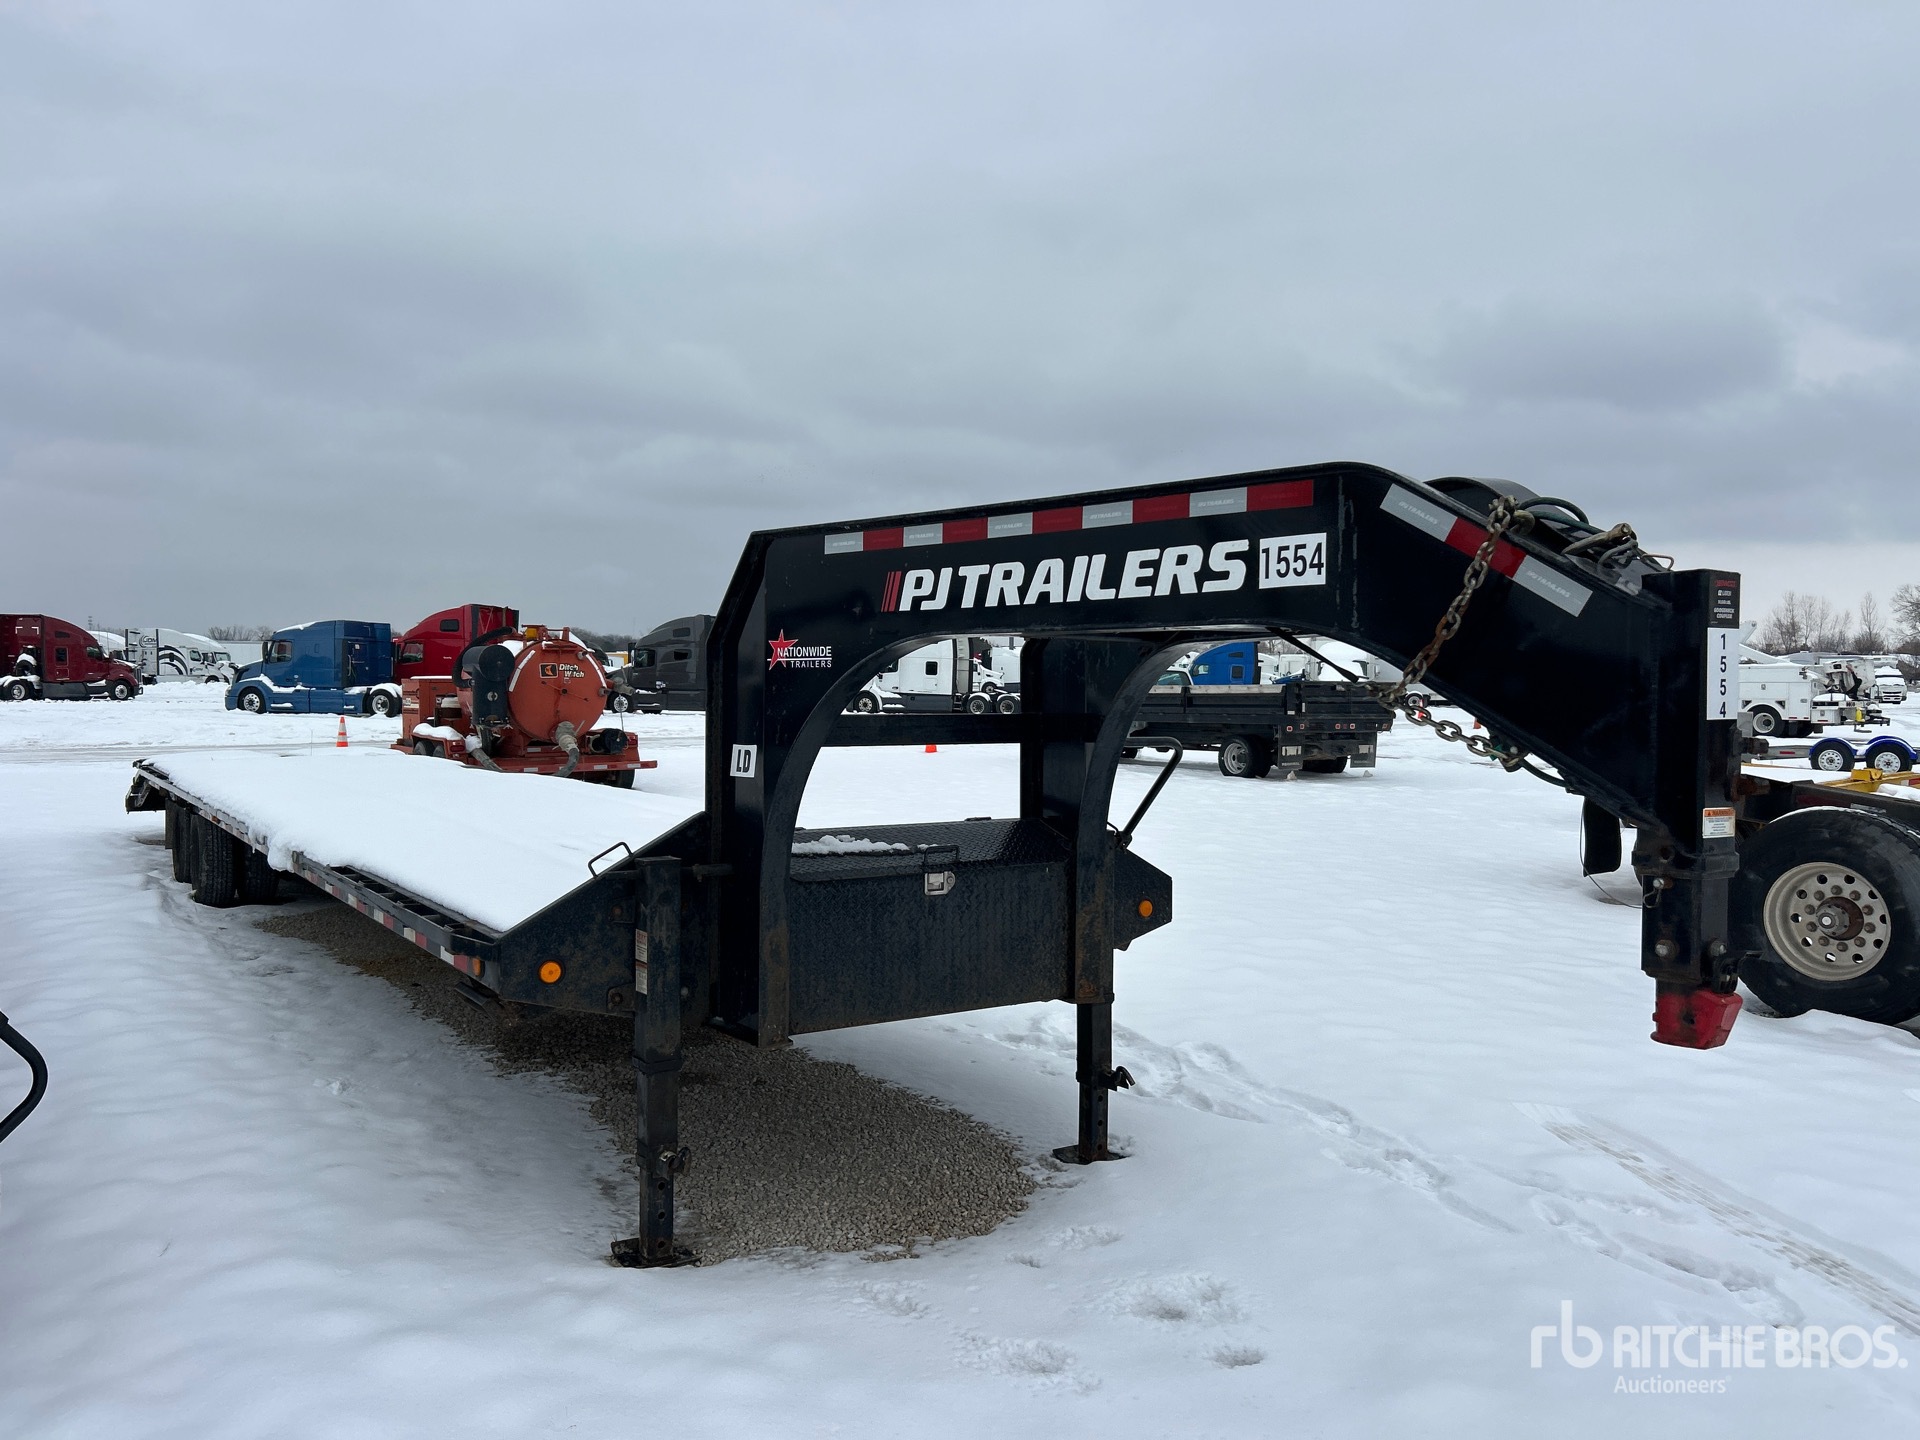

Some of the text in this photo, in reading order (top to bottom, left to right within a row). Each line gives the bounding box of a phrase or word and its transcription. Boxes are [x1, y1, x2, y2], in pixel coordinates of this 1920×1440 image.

[1261, 541, 1324, 579] 1554
[899, 539, 1250, 612] PJ TRAILERS
[778, 646, 832, 657] NATIONWIDE
[559, 663, 579, 671] Ditch
[791, 660, 832, 668] TRAILERS
[736, 749, 751, 773] LD
